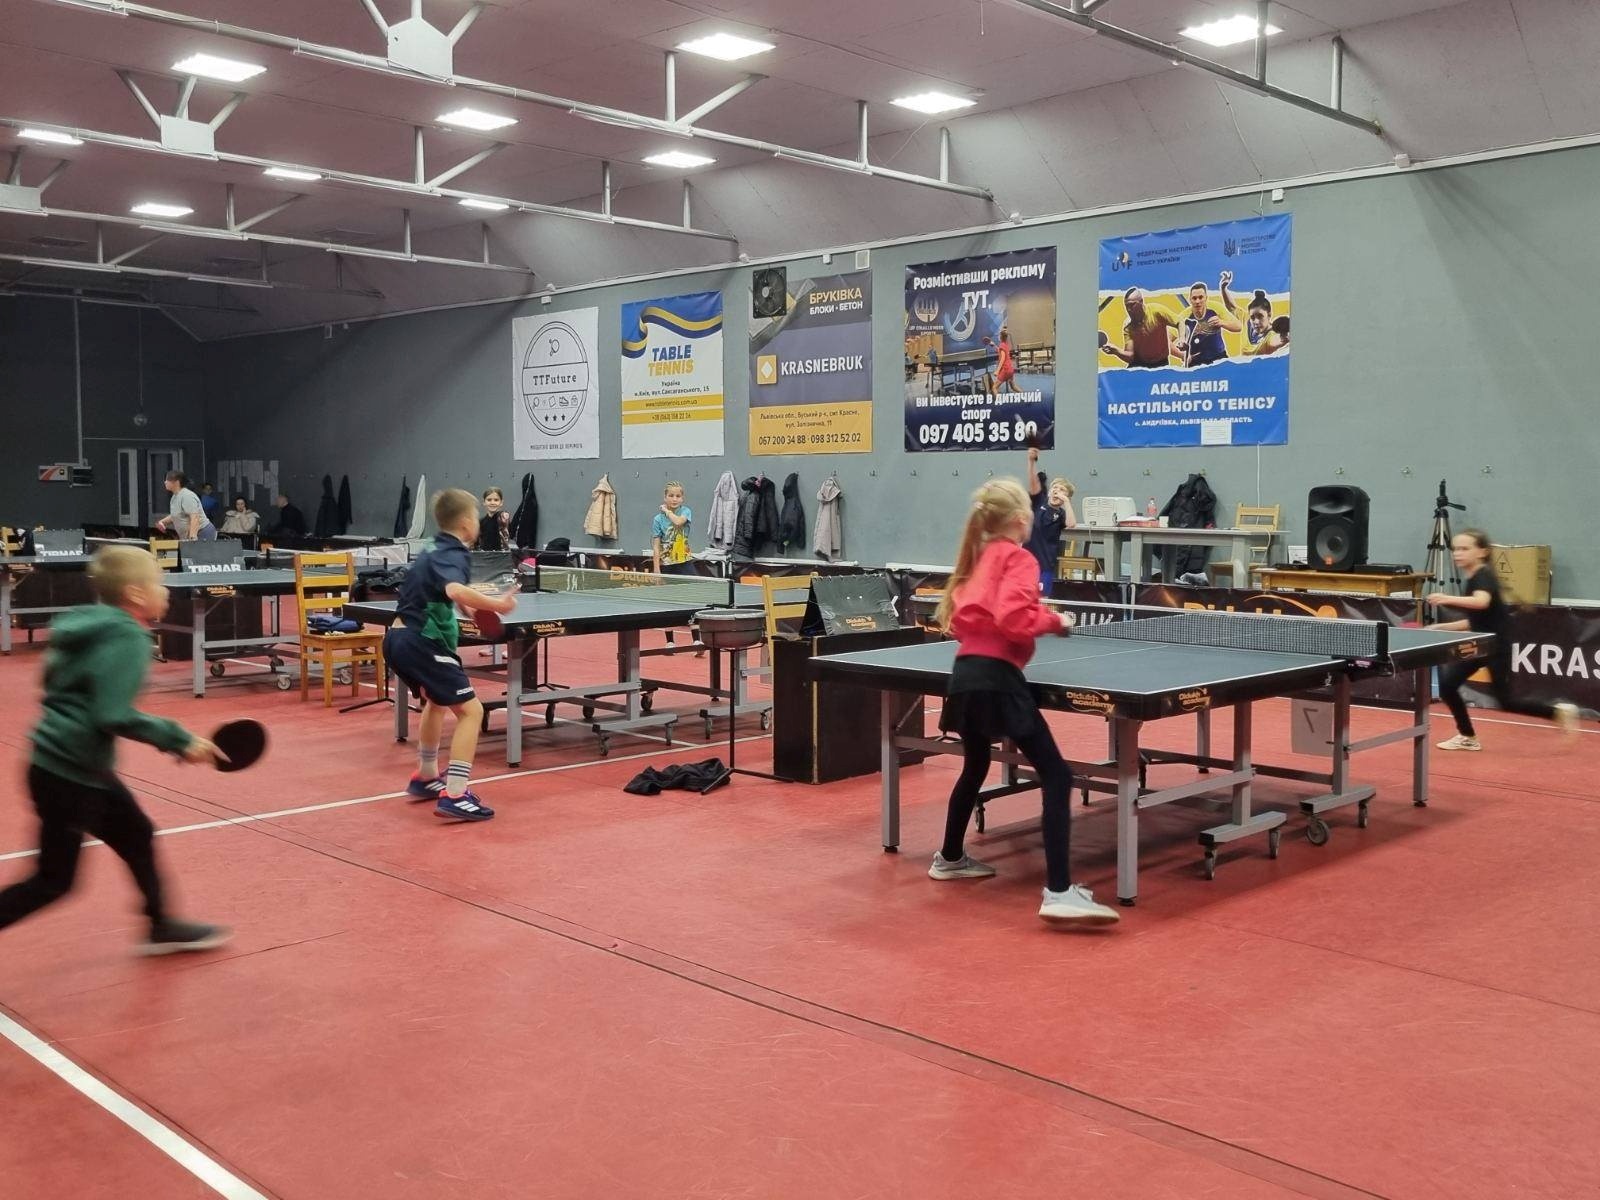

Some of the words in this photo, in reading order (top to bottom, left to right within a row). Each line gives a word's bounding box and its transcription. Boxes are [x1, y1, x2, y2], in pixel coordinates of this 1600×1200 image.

[913, 270, 988, 290] Розмістивши
[991, 262, 1046, 284] рекламу
[809, 288, 863, 304] БРУКІВКА
[809, 306, 834, 315] БЛОКИ
[839, 301, 863, 311] БЕТОН
[652, 345, 692, 361] TABLE
[648, 360, 694, 376] TENNIS
[781, 355, 863, 376] KRASNEBRUK
[533, 374, 577, 386] TTFuture
[1150, 380, 1229, 396] АКАДЕМІЯ
[916, 397, 928, 407] ви
[930, 393, 985, 408] інвестуєте
[986, 395, 993, 405] в
[994, 389, 1042, 405] дитячий
[1107, 399, 1213, 415] НАСТІЛЬНОГО
[1217, 397, 1277, 411] ТЕНІСУ
[961, 409, 992, 422] спорт
[759, 436, 771, 445] 067
[772, 436, 785, 445] 200
[787, 436, 796, 444] 34
[797, 435, 806, 443] 88
[826, 433, 839, 442] 312
[840, 433, 850, 442] 52
[851, 433, 861, 442] 02
[919, 424, 949, 444] 097
[952, 423, 984, 442] 405
[988, 422, 1009, 442] 35
[1014, 421, 1038, 441] 80
